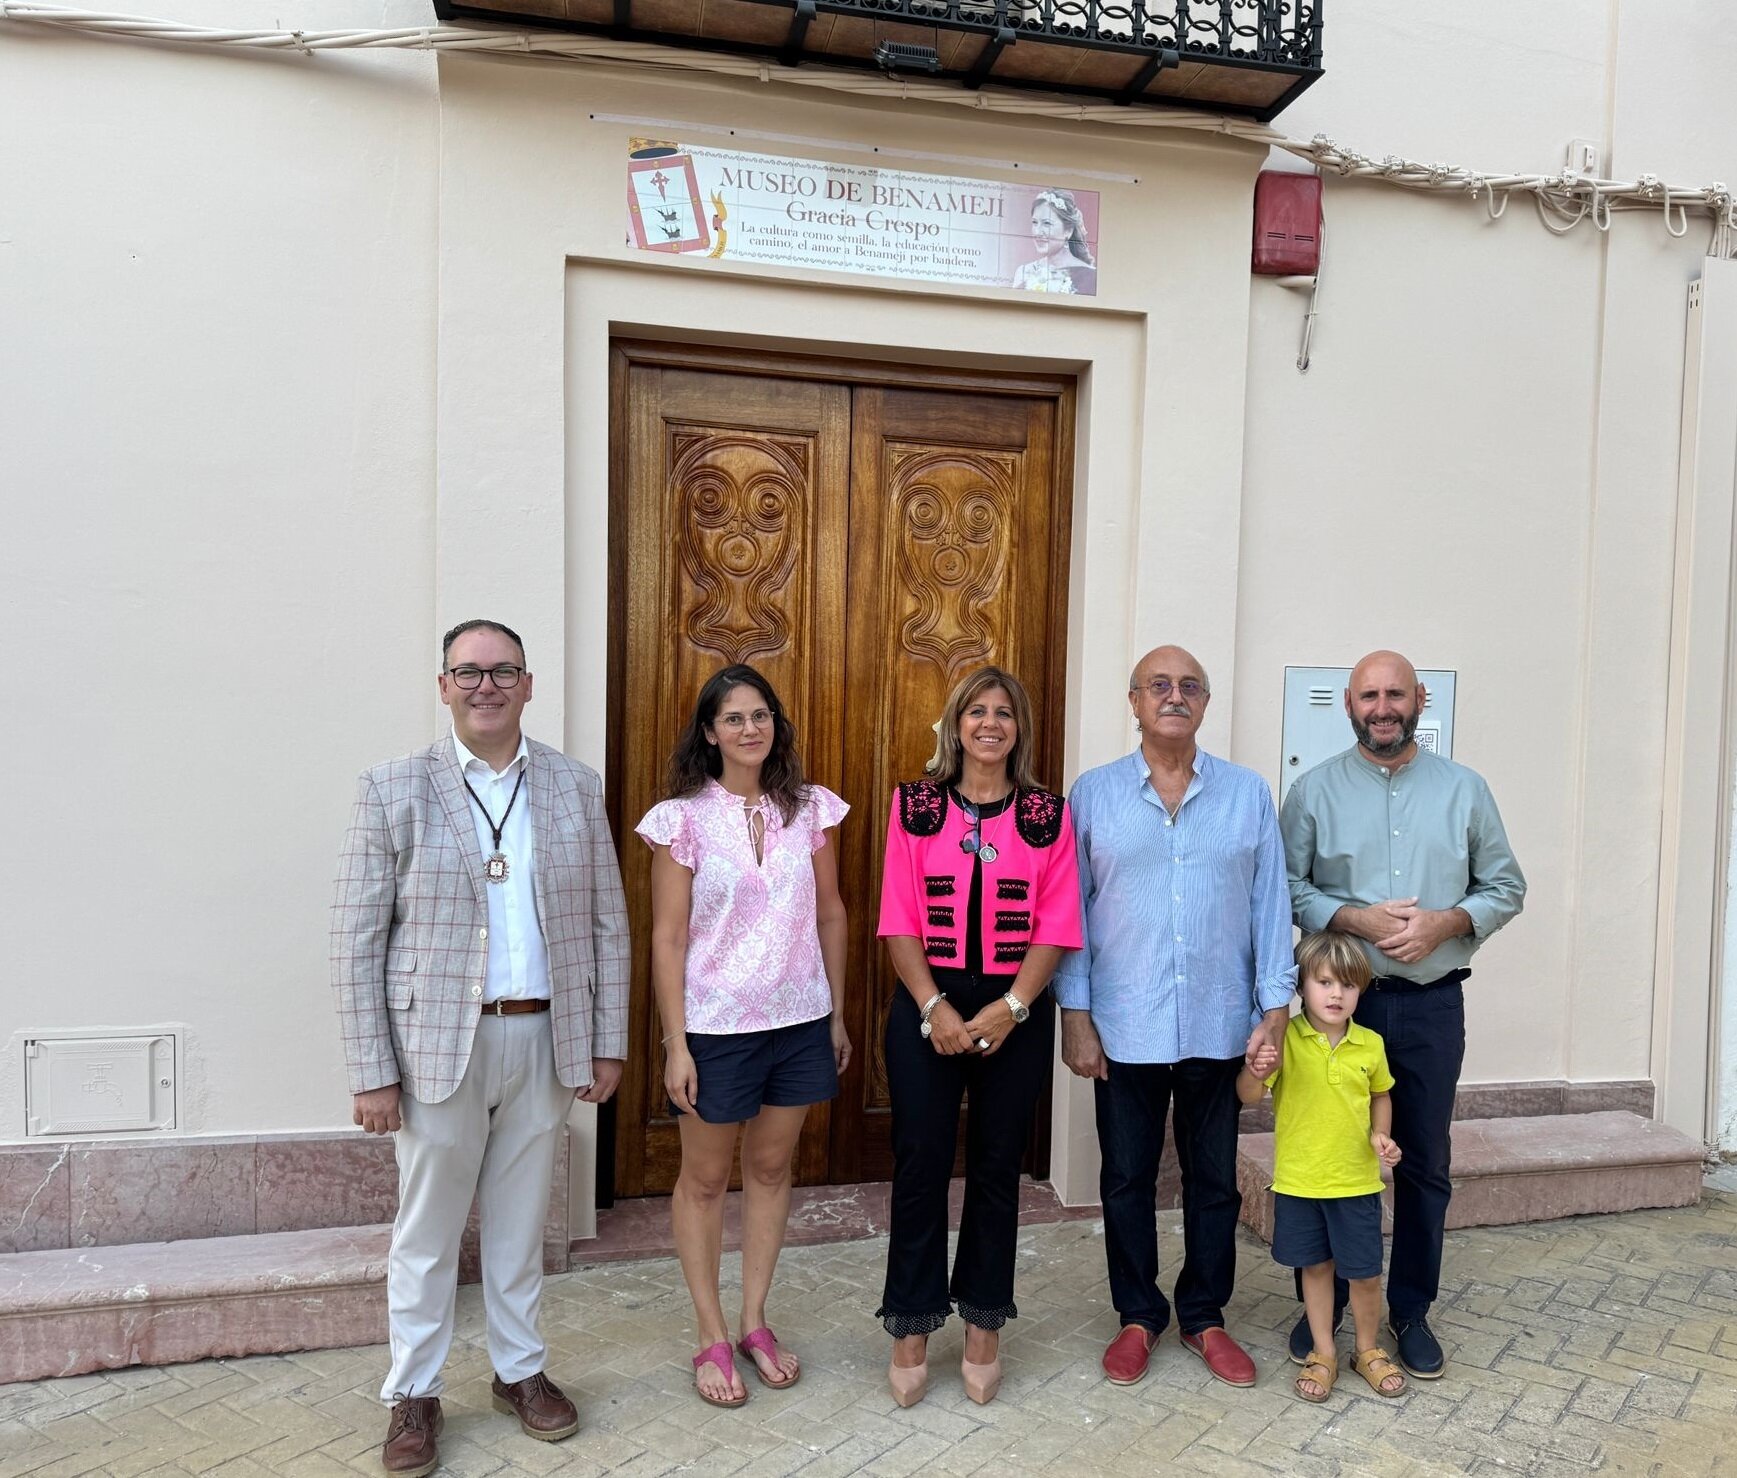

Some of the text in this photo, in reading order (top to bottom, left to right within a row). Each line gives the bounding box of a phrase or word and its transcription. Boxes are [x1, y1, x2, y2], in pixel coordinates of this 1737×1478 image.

[719, 167, 1005, 218] MUSEO DE BENAMEJÍ
[786, 201, 940, 240] Gracia Crespo
[741, 222, 755, 233] La
[760, 224, 799, 238] cultura
[803, 231, 834, 241] como
[837, 234, 878, 247] semilla,
[882, 236, 891, 247] la
[952, 246, 981, 257] como
[749, 237, 794, 249] camino,
[798, 240, 807, 250] el
[812, 244, 841, 254] amor
[844, 247, 850, 255] a
[910, 254, 929, 265] por
